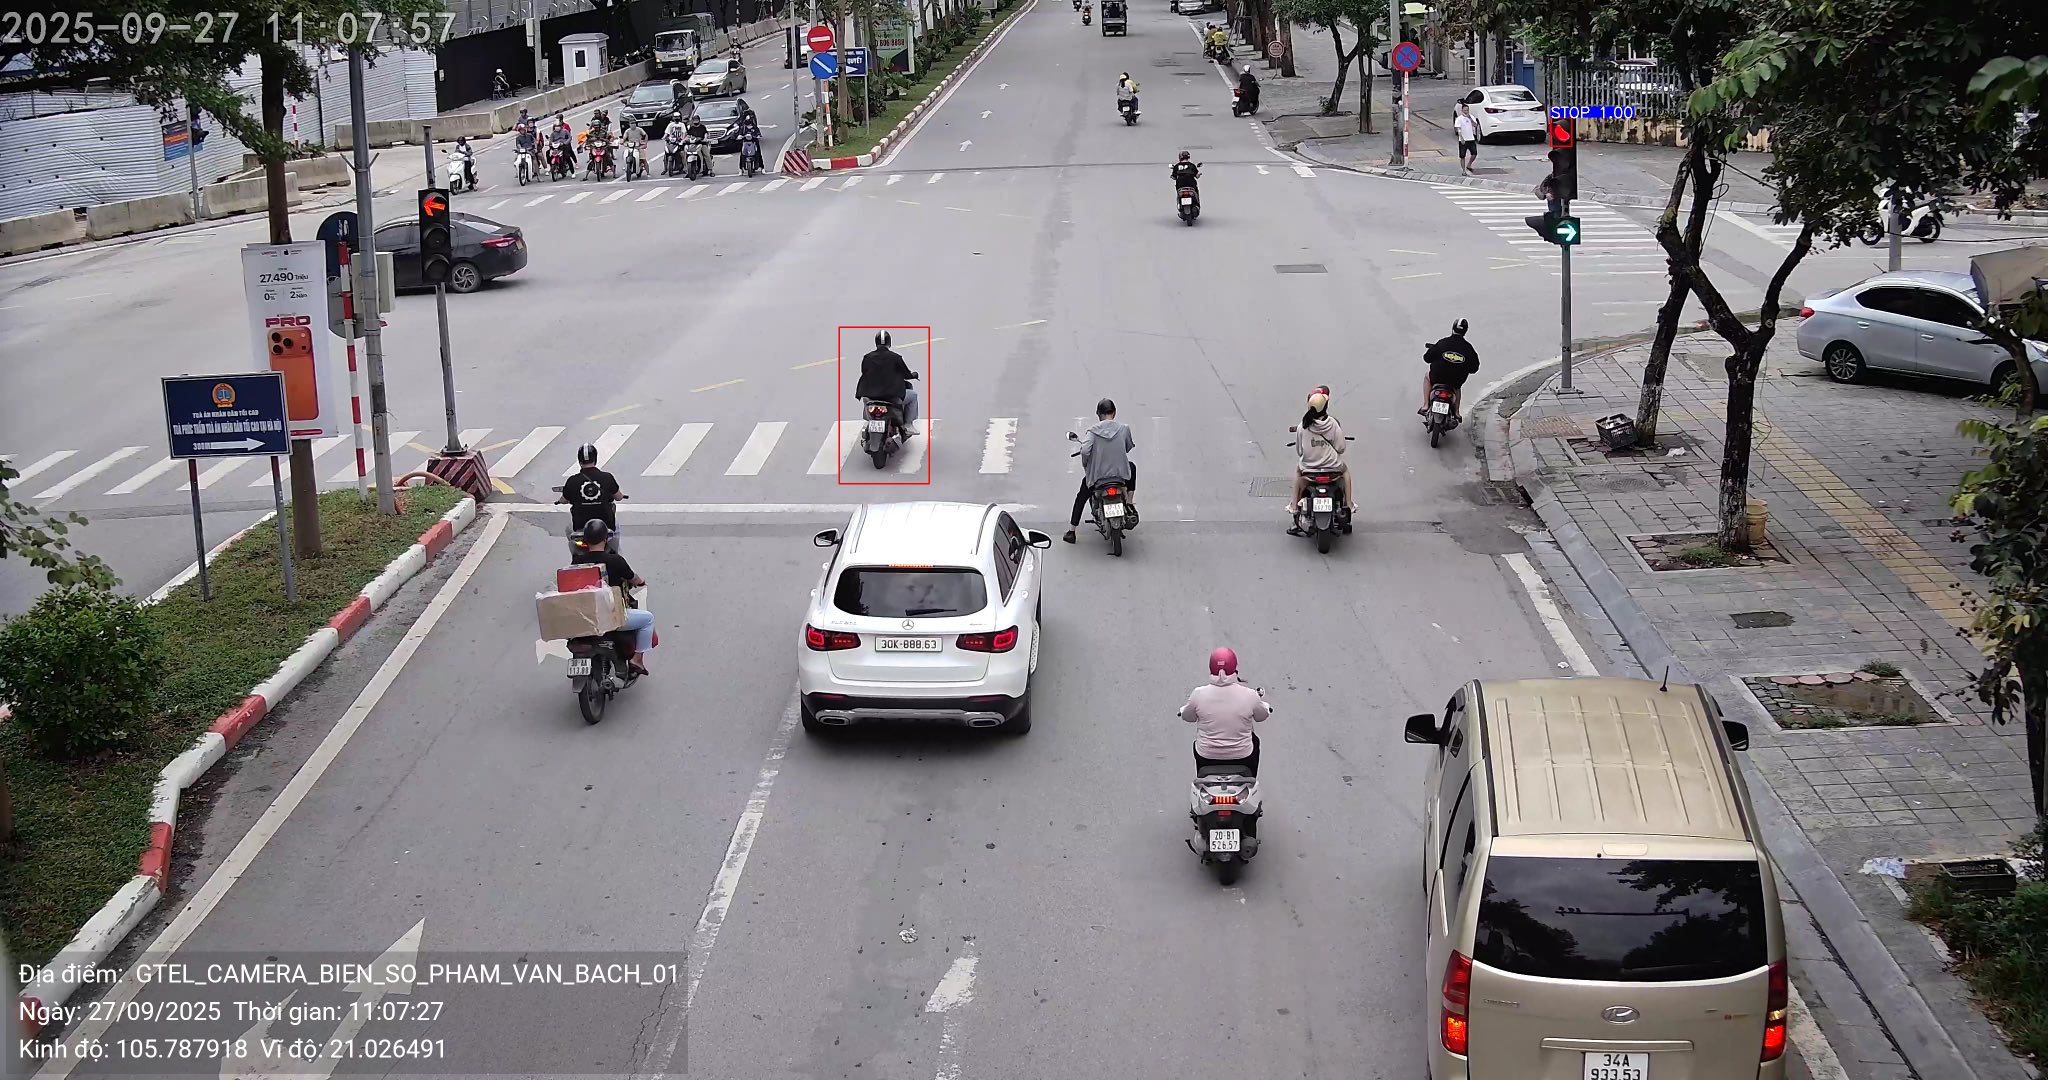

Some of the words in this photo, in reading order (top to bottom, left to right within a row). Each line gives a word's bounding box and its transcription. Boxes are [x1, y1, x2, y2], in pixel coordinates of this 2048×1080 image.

[259, 272, 294, 283] 27.490
[265, 315, 311, 328] PRO
[881, 639, 937, 650] 30K-888.63
[1215, 831, 1235, 840] 20-B1
[1212, 841, 1237, 850] 526.57
[1603, 1053, 1630, 1067] 34A
[1590, 1068, 1641, 1080] 933.53
